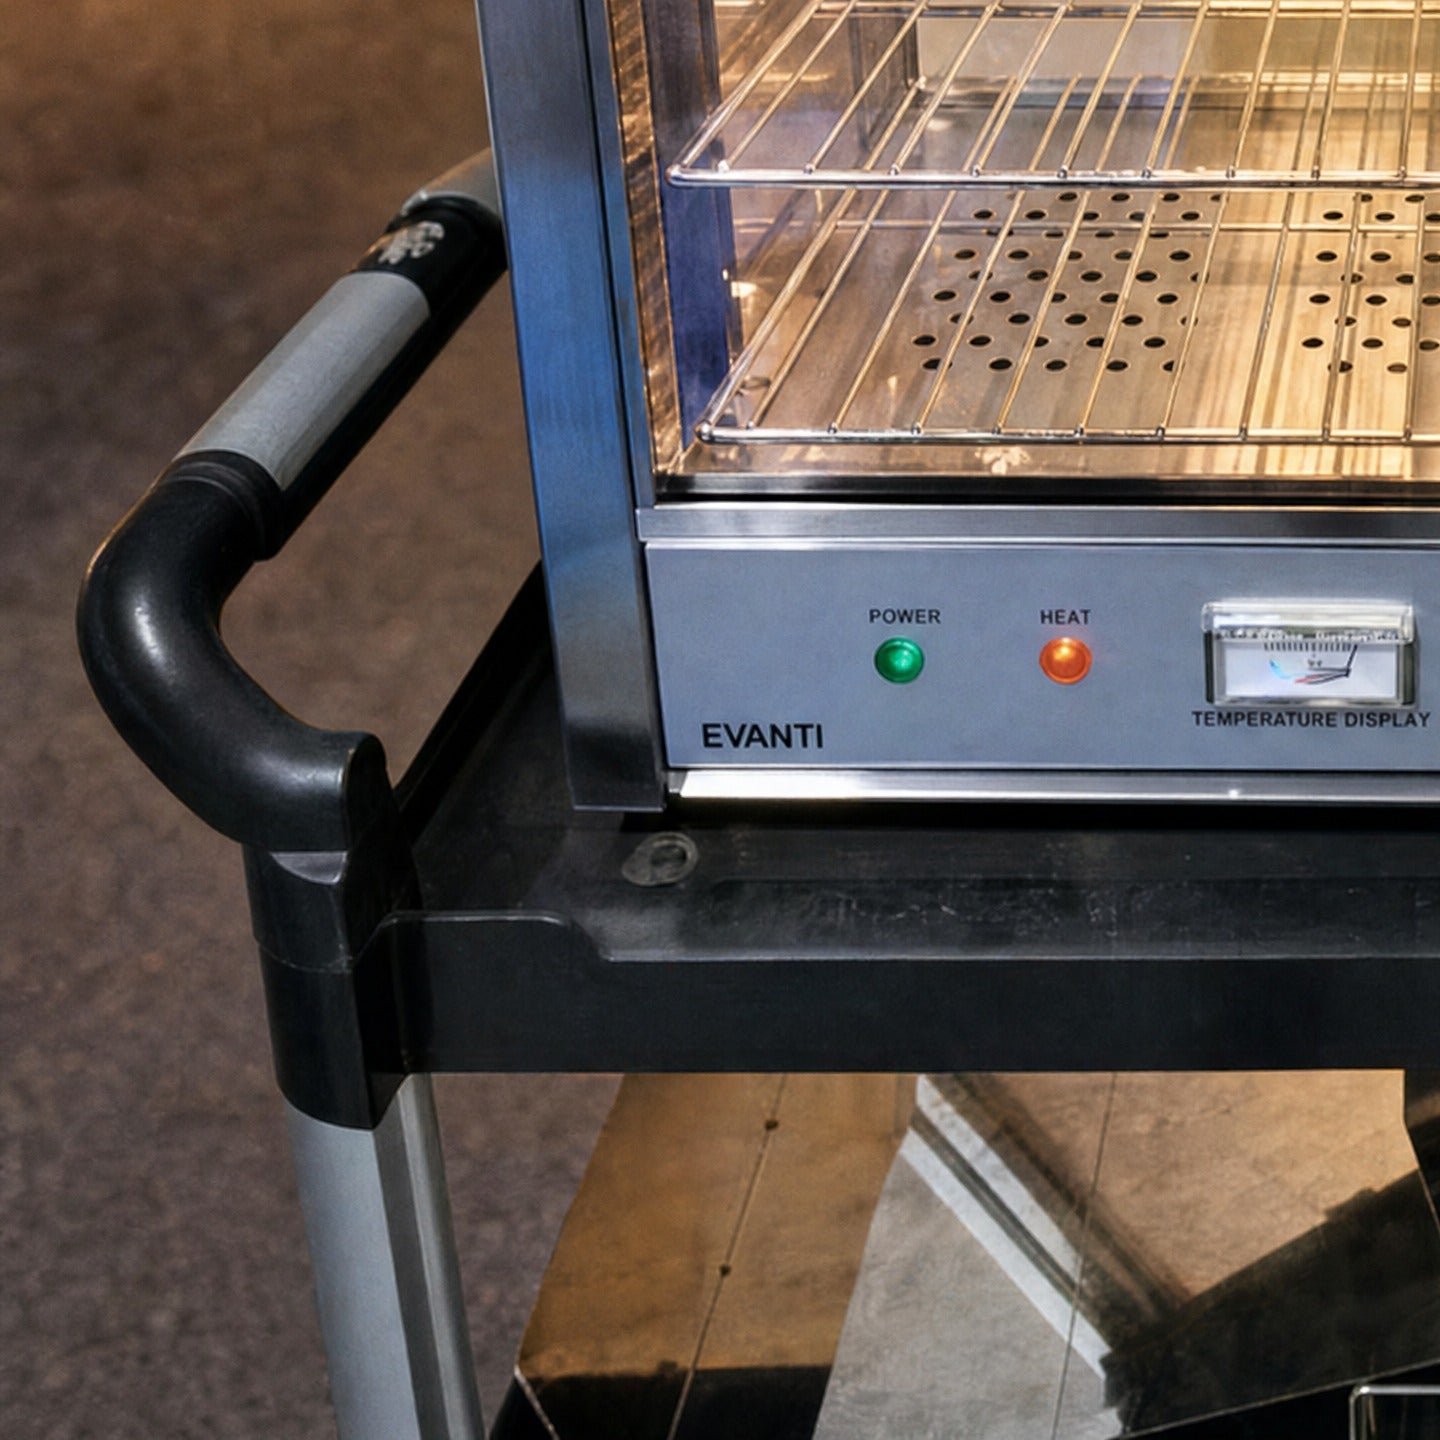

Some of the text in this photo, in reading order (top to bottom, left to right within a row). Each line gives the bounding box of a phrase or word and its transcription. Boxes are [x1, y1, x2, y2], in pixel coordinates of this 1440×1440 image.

[869, 608, 941, 625] POWER
[1040, 608, 1091, 625] HEAT
[1192, 710, 1431, 728] TEMPERATURE DISPLAY
[701, 722, 824, 749] EVANTI
